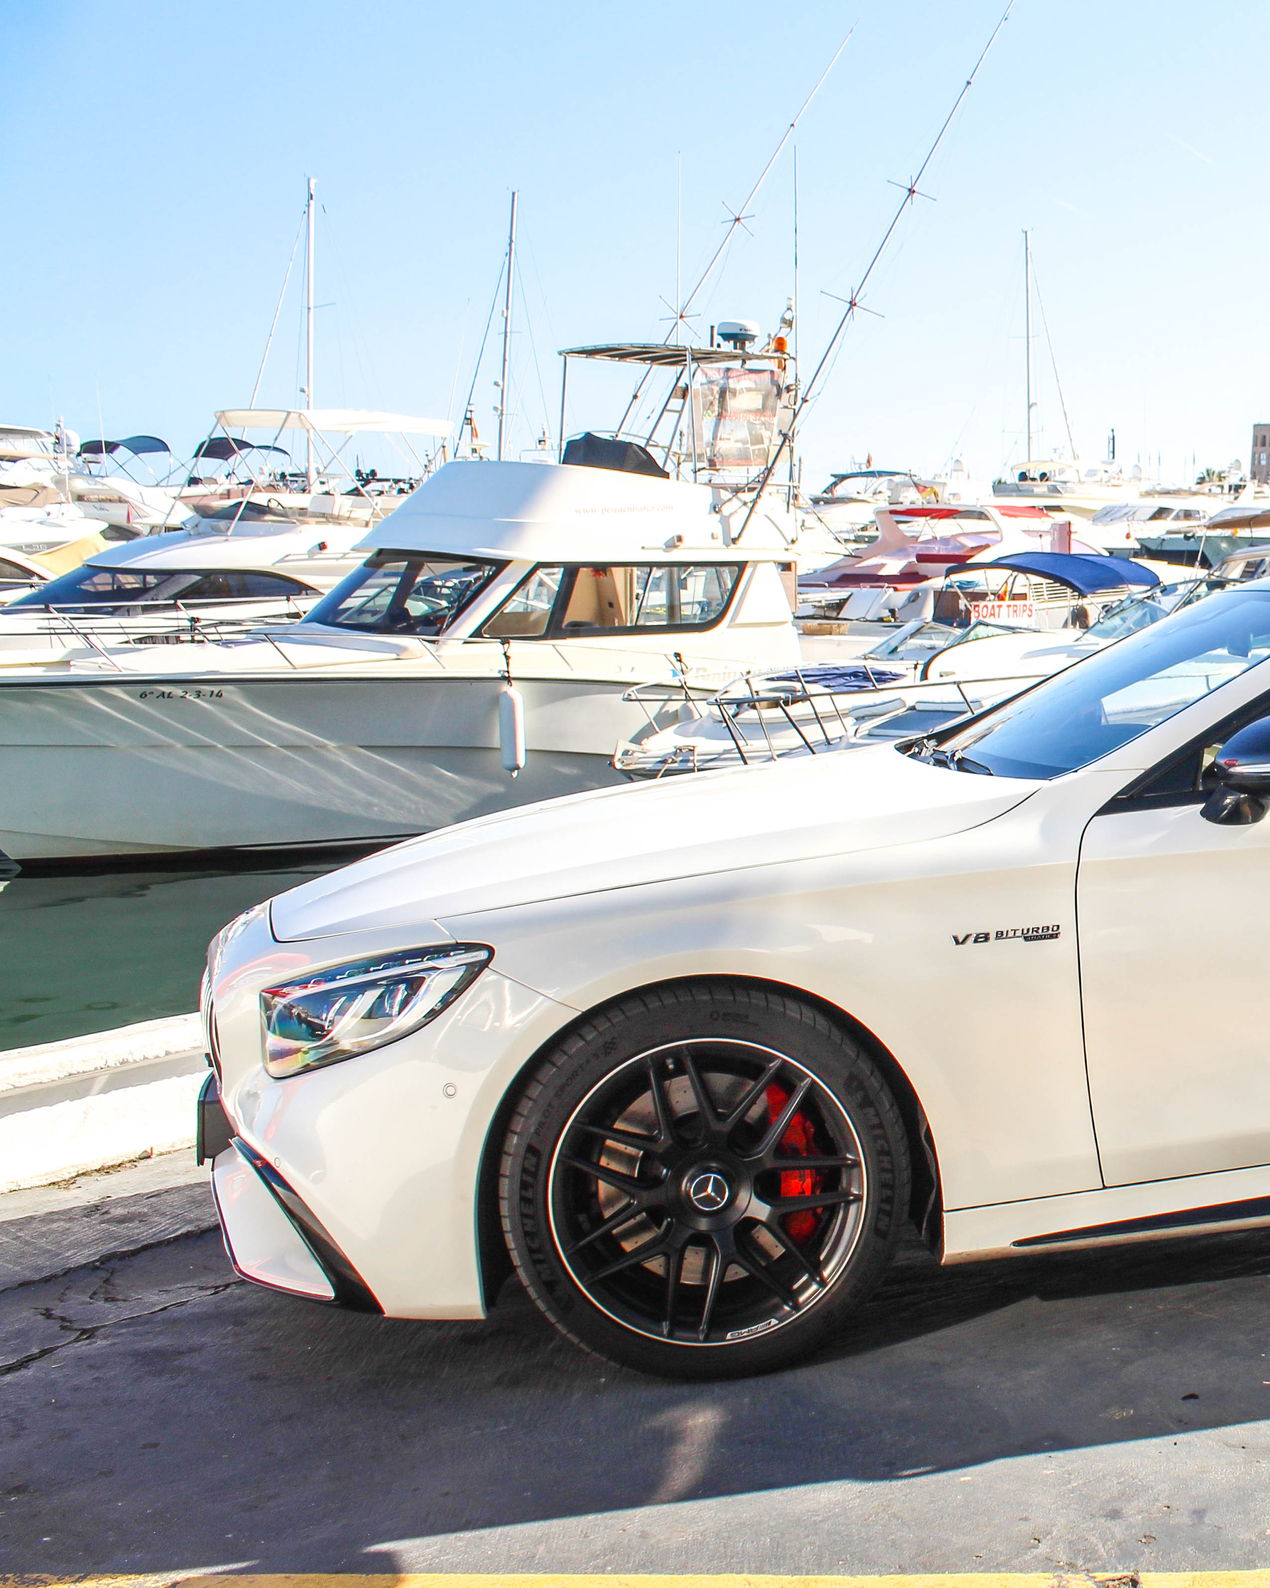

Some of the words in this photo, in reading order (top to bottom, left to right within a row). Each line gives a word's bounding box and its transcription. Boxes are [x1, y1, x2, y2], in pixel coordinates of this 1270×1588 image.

[973, 604, 1003, 619] BOAT
[1006, 603, 1034, 618] TRIPS
[156, 691, 174, 699] AL
[180, 689, 224, 699] 2-3-14
[952, 932, 990, 945] V8
[995, 924, 1060, 938] BITURBO
[865, 1107, 892, 1231] MICHELIN
[523, 1153, 553, 1281] MICHELIN
